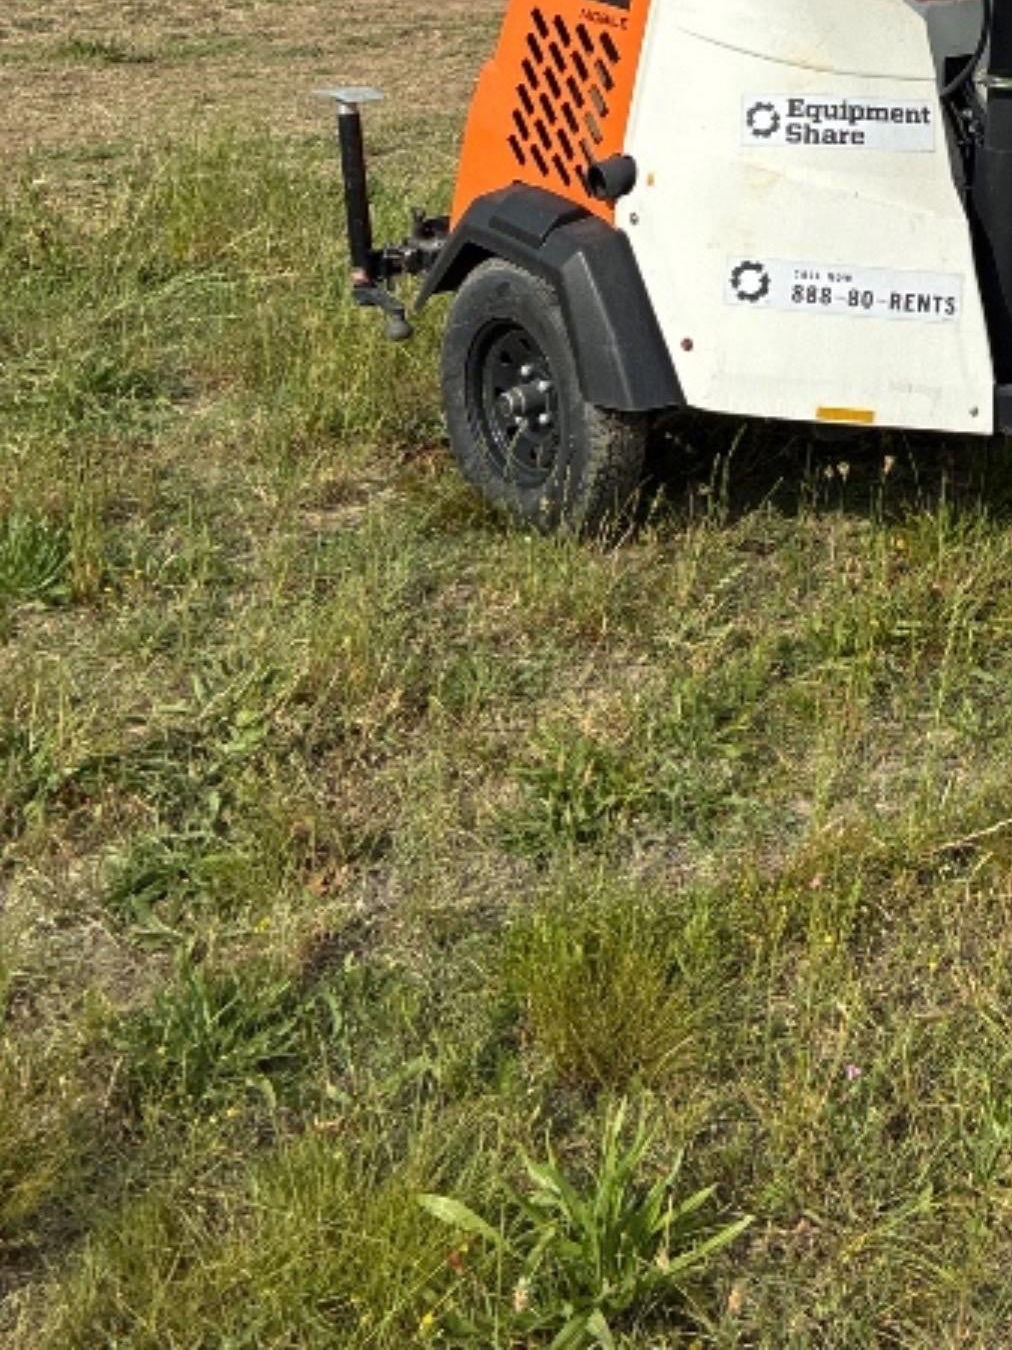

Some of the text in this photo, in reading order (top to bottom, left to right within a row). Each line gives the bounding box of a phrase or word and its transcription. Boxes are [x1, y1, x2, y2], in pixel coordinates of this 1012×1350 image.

[786, 98, 931, 125] Equipment
[785, 123, 865, 145] Share
[791, 284, 956, 316] 888-80-RENTS
